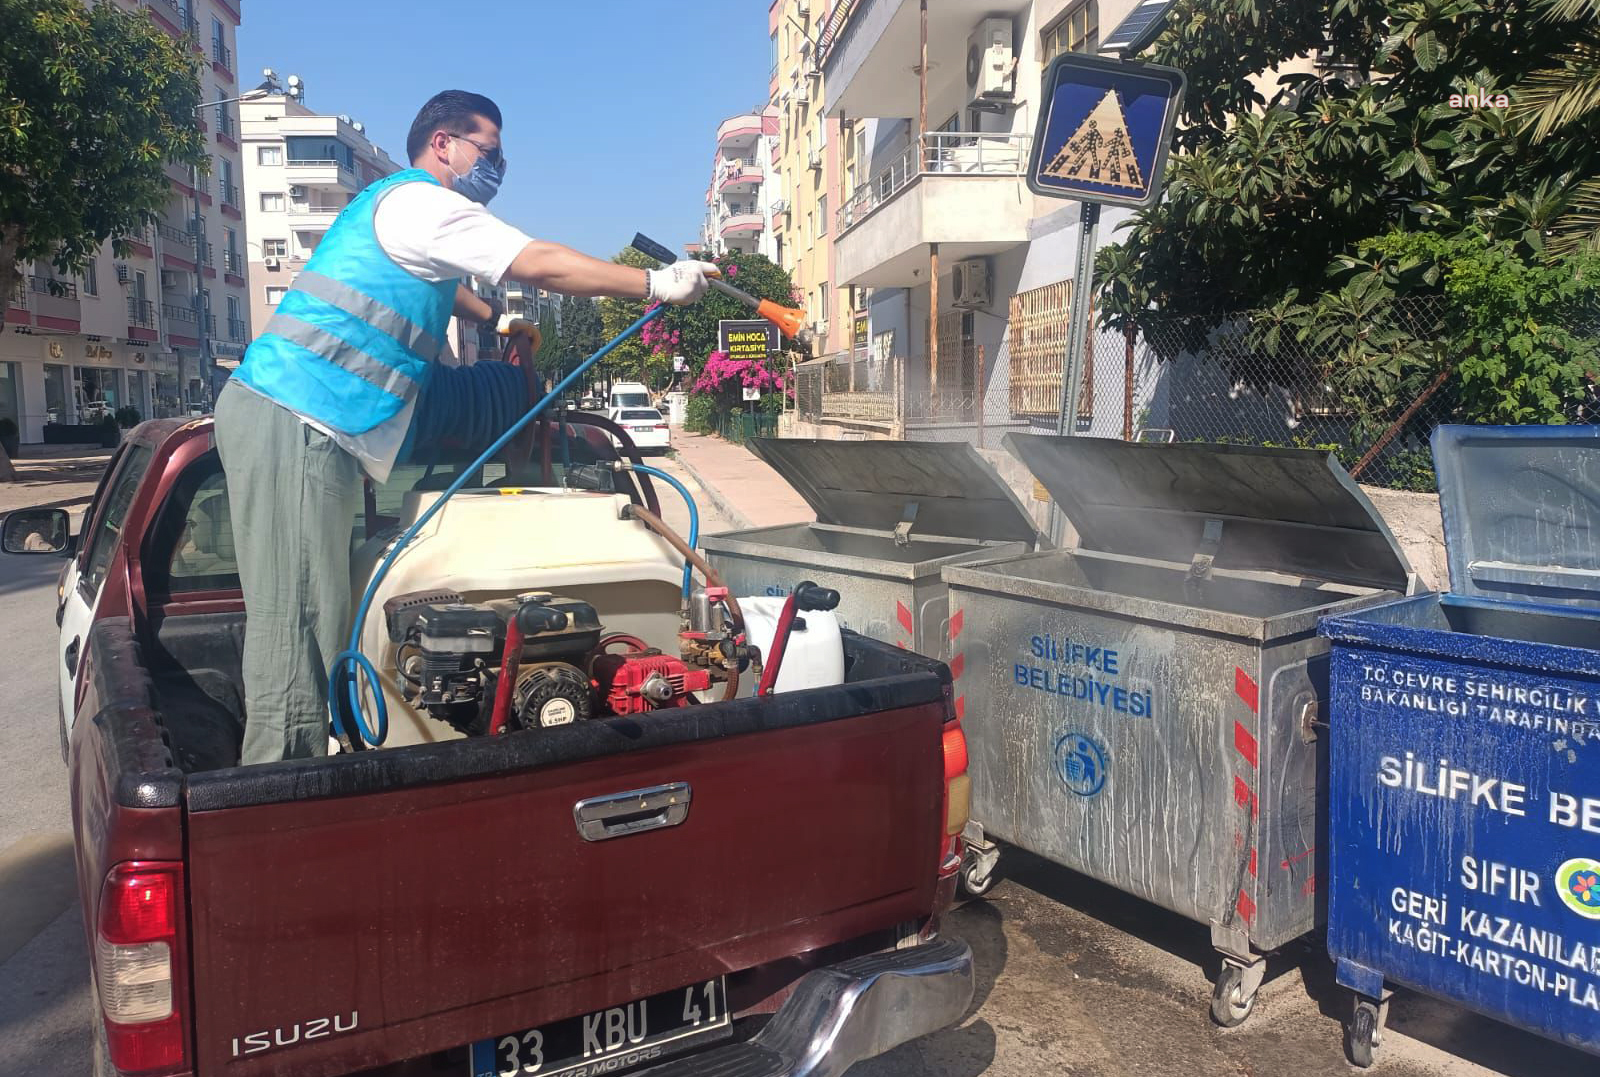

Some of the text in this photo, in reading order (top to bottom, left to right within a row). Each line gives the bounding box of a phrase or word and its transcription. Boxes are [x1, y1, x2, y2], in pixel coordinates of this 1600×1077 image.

[728, 331, 766, 342] EMİN HOCA
[1014, 664, 1152, 719] BELEDİYESİ
[1380, 752, 1526, 817] SİLİFKE
[1461, 855, 1541, 907] SIFIR
[1391, 887, 1447, 926] GERİ
[232, 1010, 358, 1057] ISUZU
[498, 980, 717, 1077] 33 KBU 41
[591, 1046, 662, 1076] MOTORS
